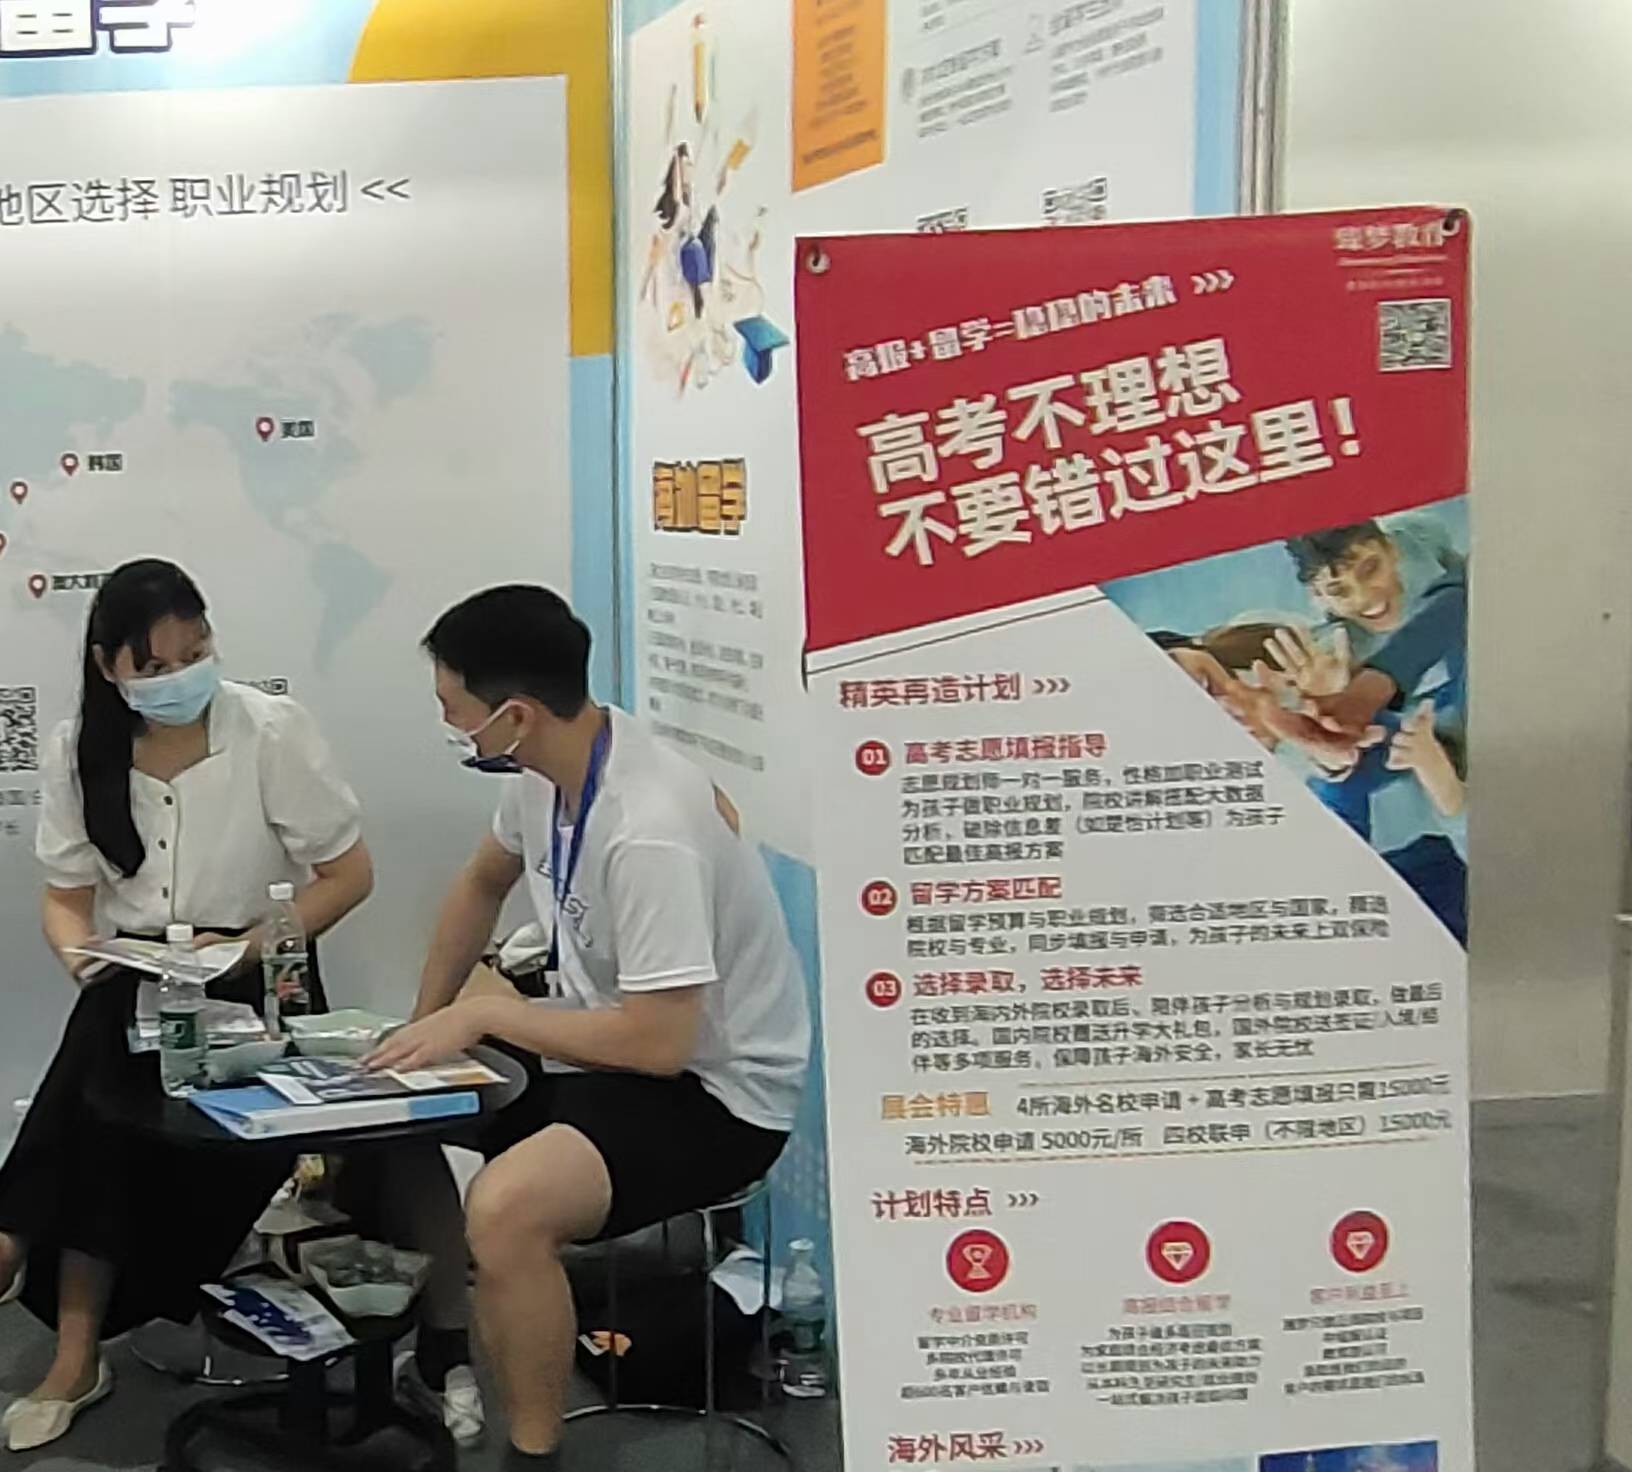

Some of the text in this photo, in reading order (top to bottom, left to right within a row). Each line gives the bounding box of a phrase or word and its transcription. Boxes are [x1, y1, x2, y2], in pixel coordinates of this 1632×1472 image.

[170, 170, 349, 219] 职业规划
[858, 338, 1241, 493] 高考不理想
[88, 453, 123, 471] 韩国
[653, 458, 746, 536] 海外留学
[53, 572, 112, 590] 澳大利
[839, 673, 1021, 709] 精英再造计划
[905, 732, 1107, 765] 高考志愿填报指导
[910, 876, 1062, 905] 留学方案匹配
[913, 965, 1143, 997] 选择录取，选择未来
[881, 1091, 991, 1120] 展会特惠
[904, 1131, 1035, 1156] 海外院校申请
[1041, 1126, 1143, 1150] 5000元/所
[872, 1187, 991, 1220] 计划特点
[887, 1431, 1006, 1464] 海外风采
